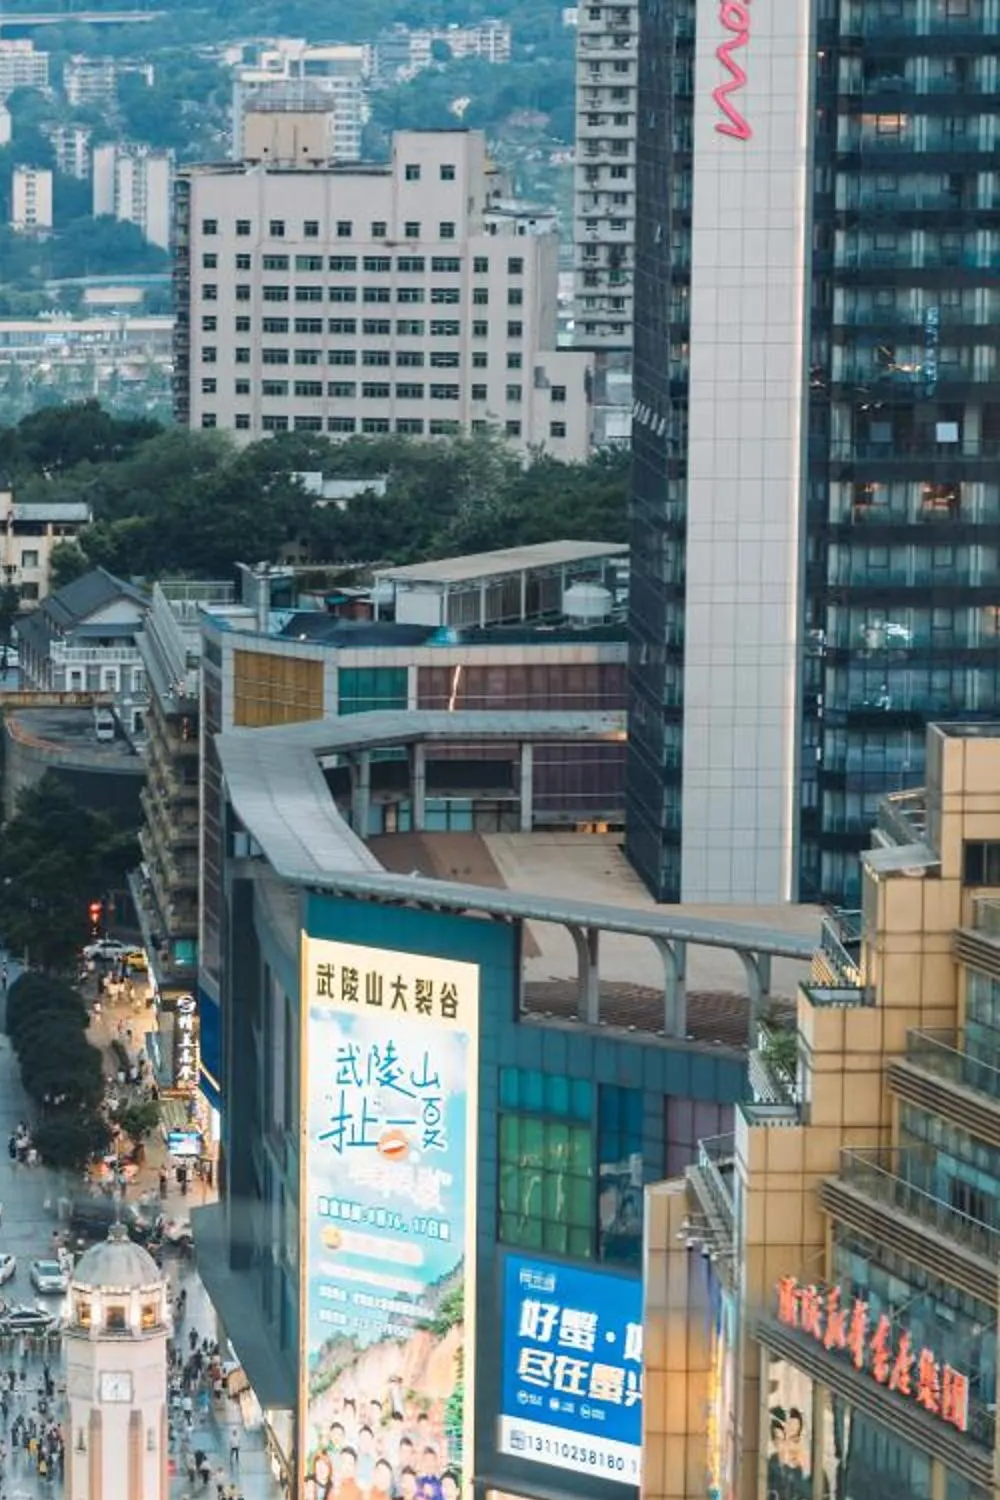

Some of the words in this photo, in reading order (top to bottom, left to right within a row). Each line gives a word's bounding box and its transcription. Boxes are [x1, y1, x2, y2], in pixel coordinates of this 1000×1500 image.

[316, 962, 459, 1019] 武陵山大裂谷
[336, 1039, 442, 1099] 武陵山
